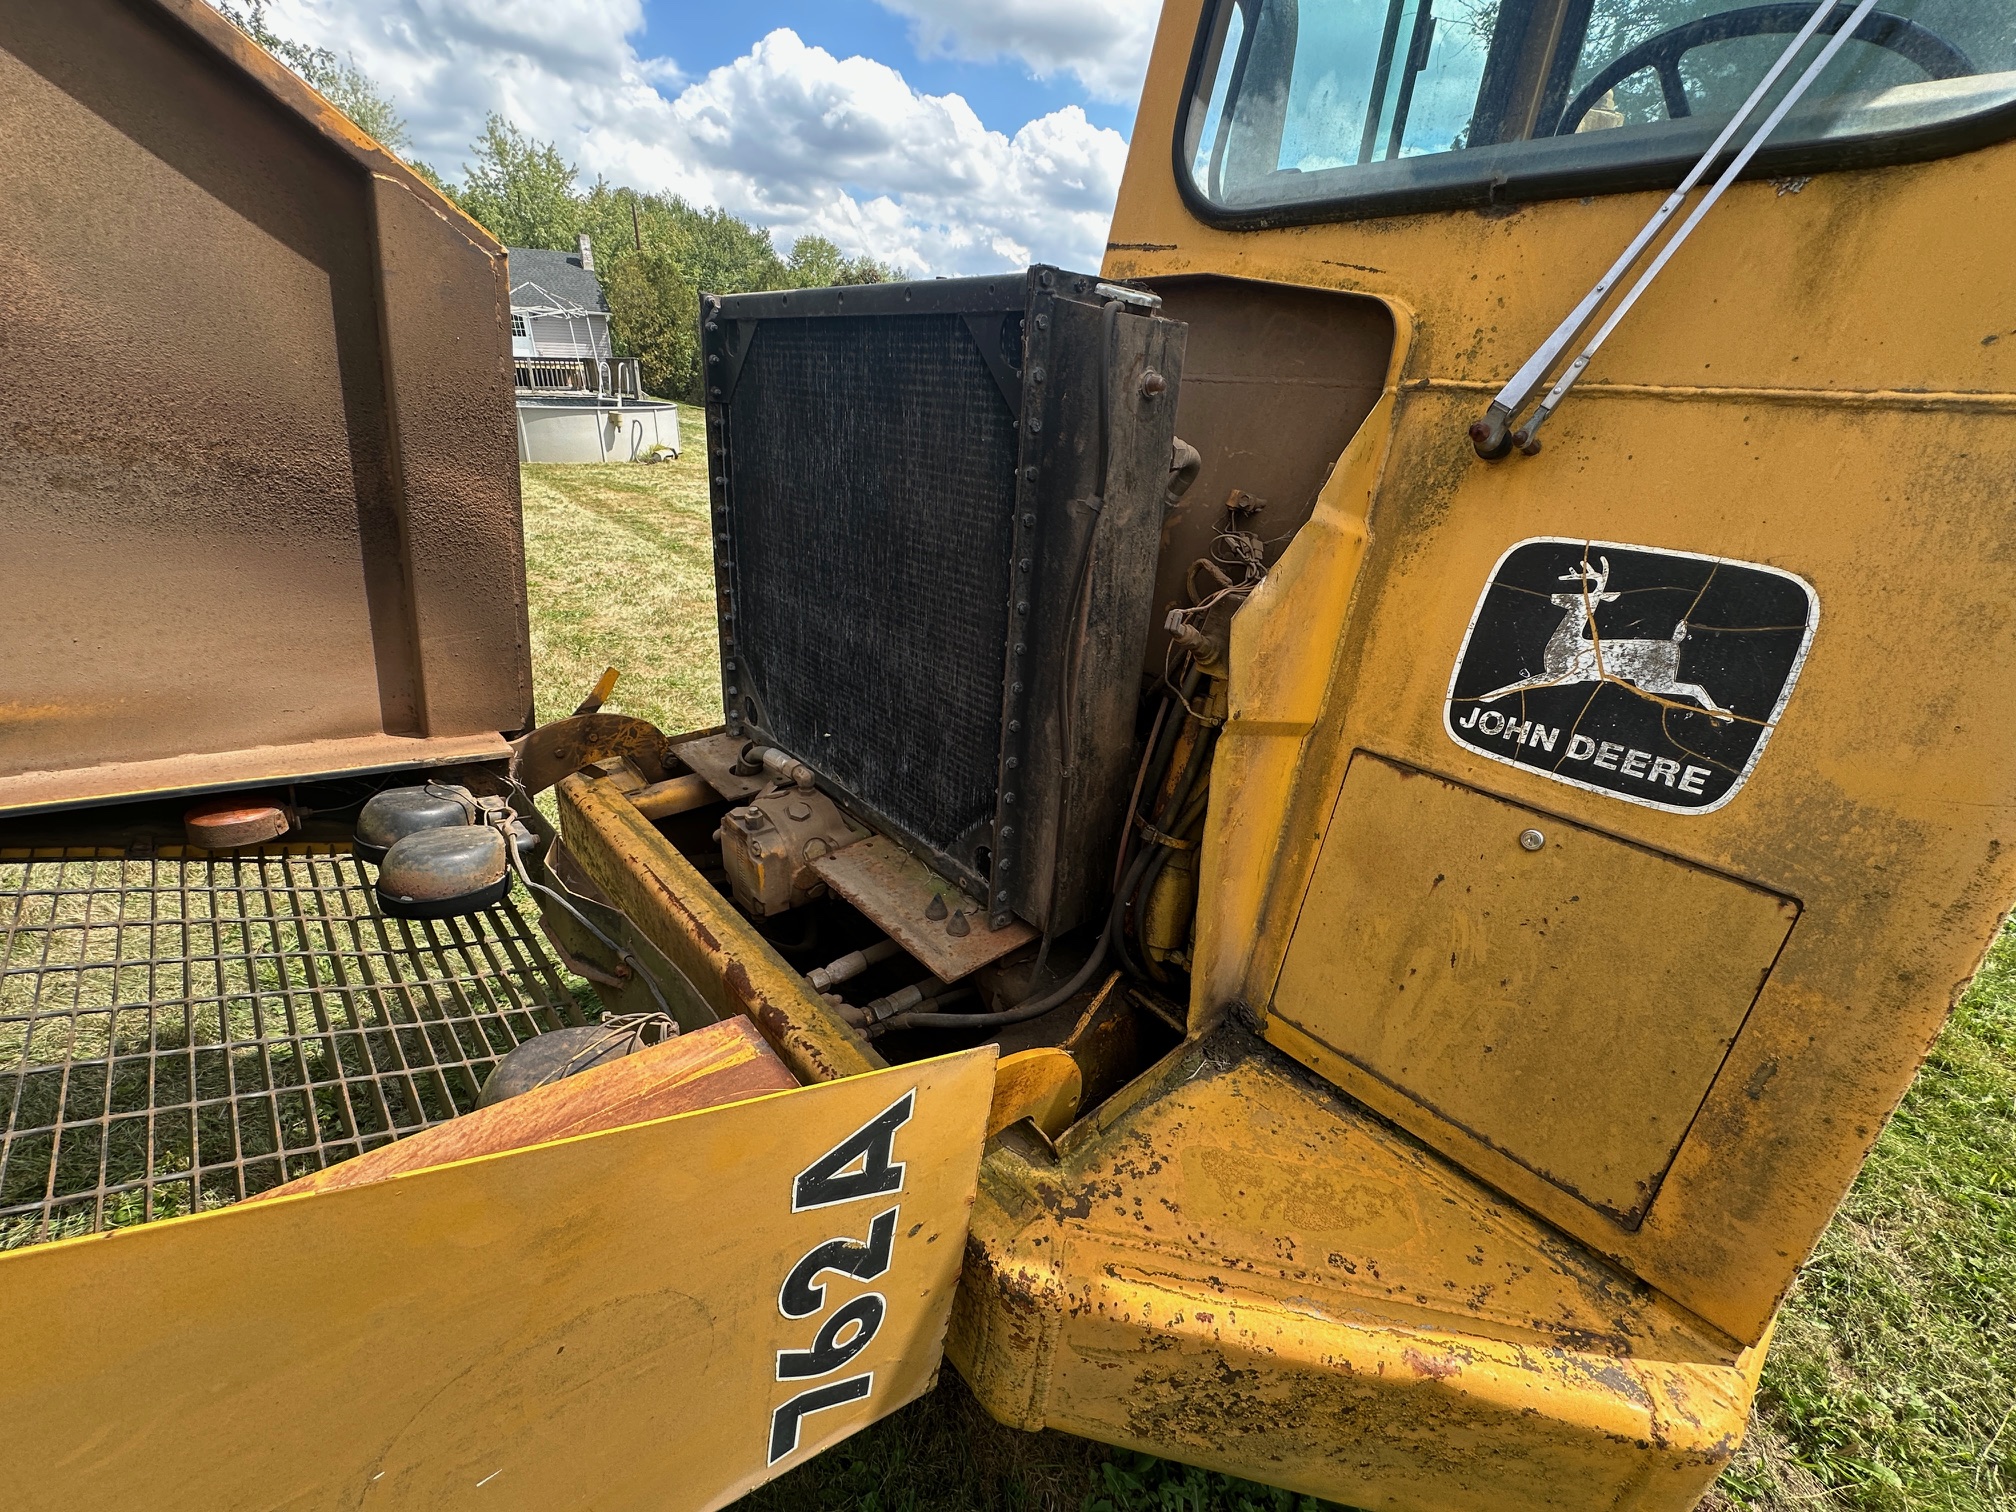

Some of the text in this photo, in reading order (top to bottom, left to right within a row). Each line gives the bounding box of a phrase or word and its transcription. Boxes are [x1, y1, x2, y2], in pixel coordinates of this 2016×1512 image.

[1459, 707, 1712, 795] JOHN DEERE
[767, 1086, 917, 1468] 762A
